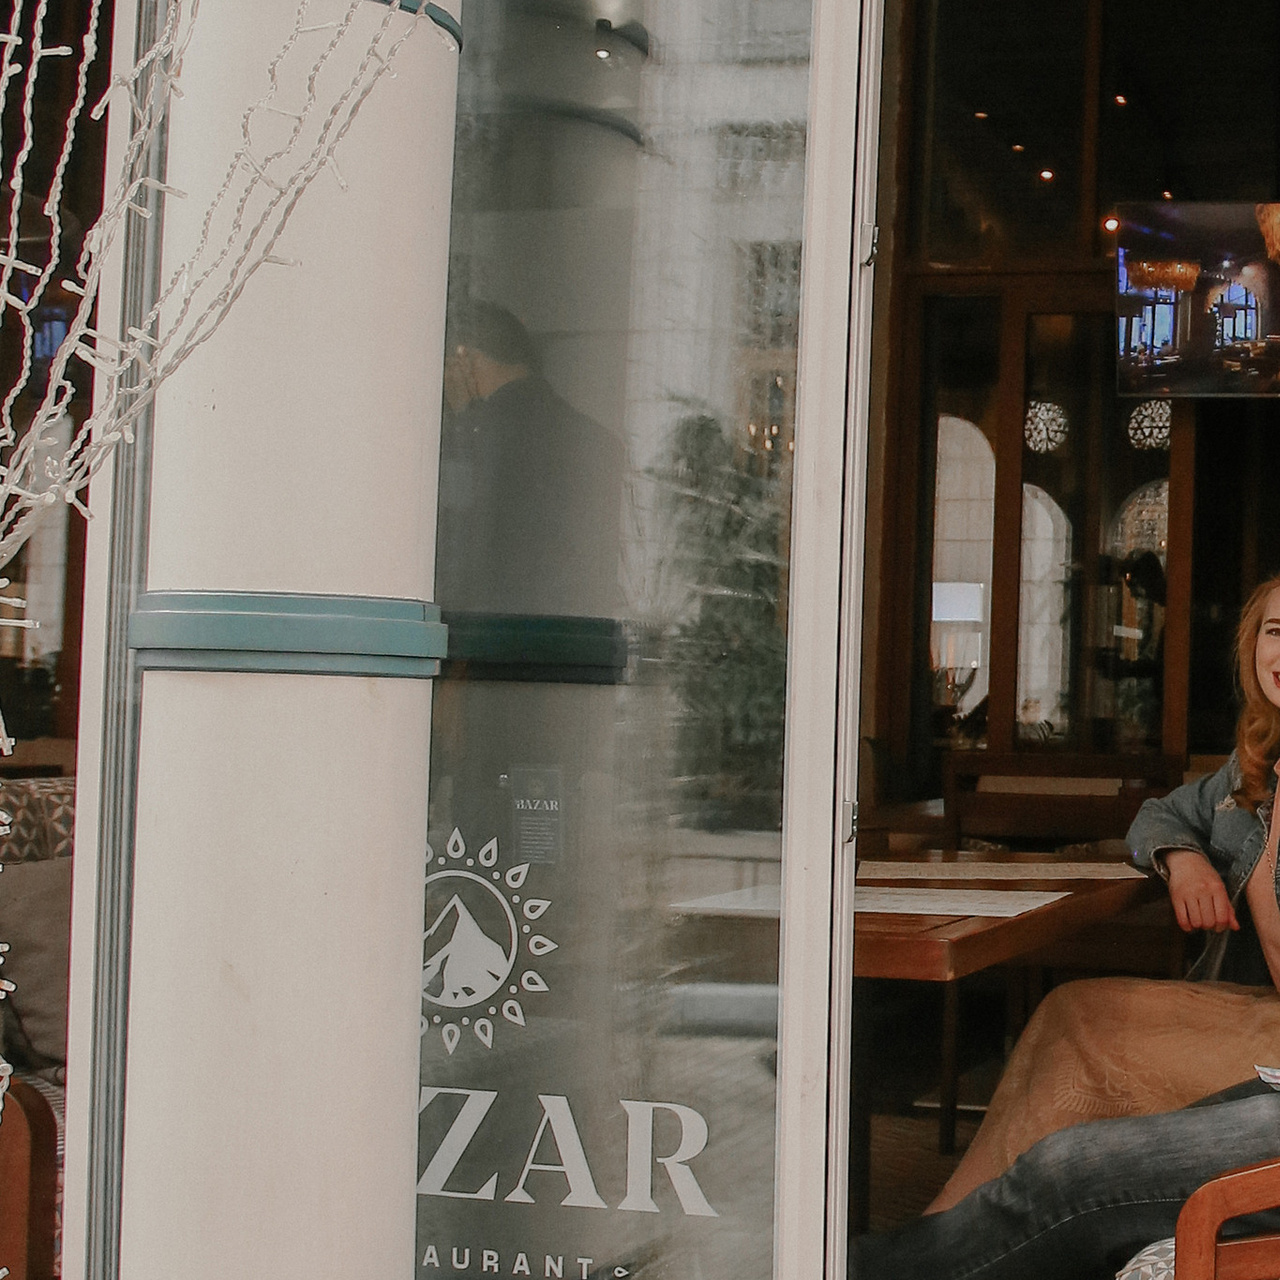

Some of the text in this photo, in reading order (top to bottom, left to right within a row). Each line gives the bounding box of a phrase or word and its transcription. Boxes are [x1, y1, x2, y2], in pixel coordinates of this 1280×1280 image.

[516, 799, 559, 811] BAZAR
[416, 1086, 719, 1217] ZAR
[422, 1245, 593, 1280] AURANT
